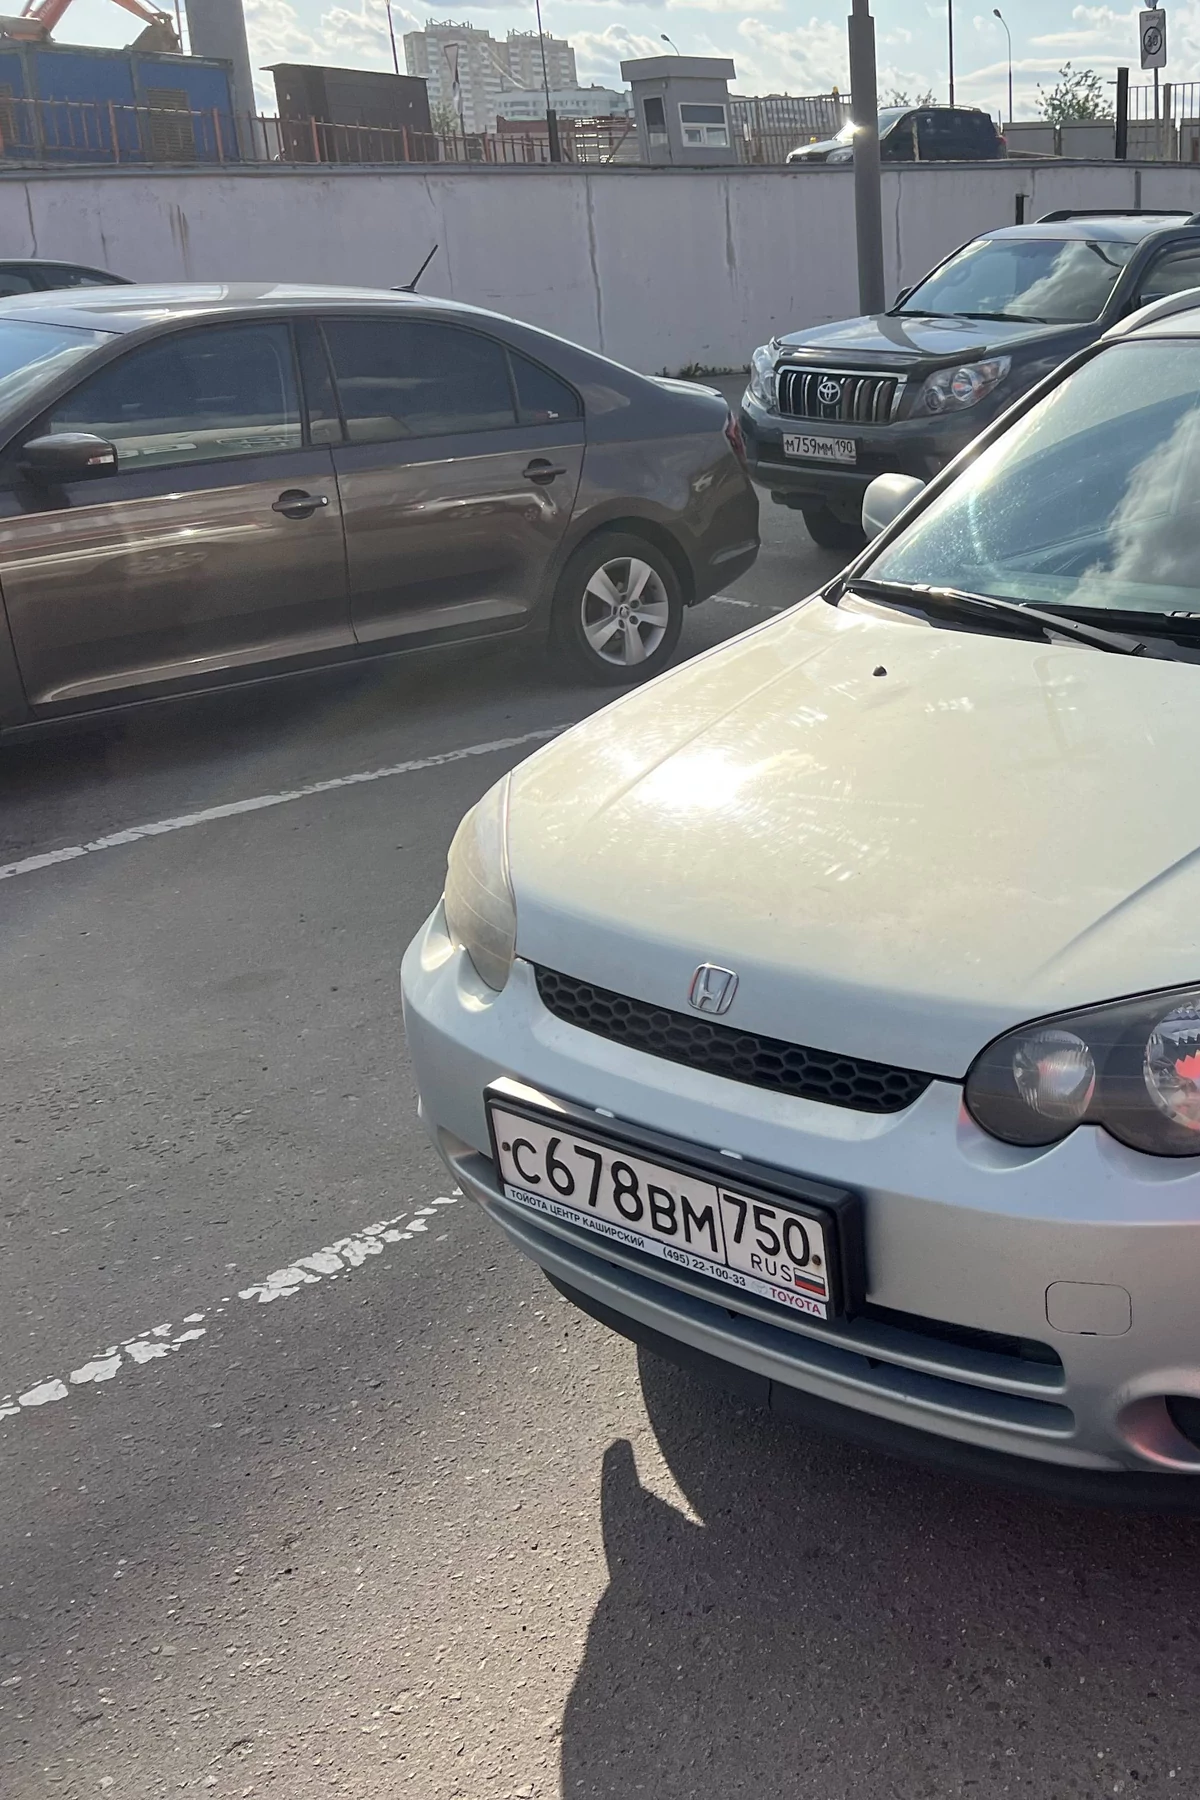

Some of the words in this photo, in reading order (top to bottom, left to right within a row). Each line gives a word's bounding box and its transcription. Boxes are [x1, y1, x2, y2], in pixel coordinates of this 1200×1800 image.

[835, 440, 853, 453] 190
[511, 1189, 548, 1211] ТОЙОТА
[550, 1205, 580, 1222] ЦЕНТР
[583, 1218, 645, 1248] КАШИРСКИЙ
[512, 1137, 718, 1252] С678ВМ
[723, 1194, 810, 1267] 750
[663, 1247, 690, 1266] (495)
[692, 1259, 746, 1287] 22-100-33
[751, 1253, 793, 1283] RUS
[769, 1287, 822, 1315] TOYOTA
